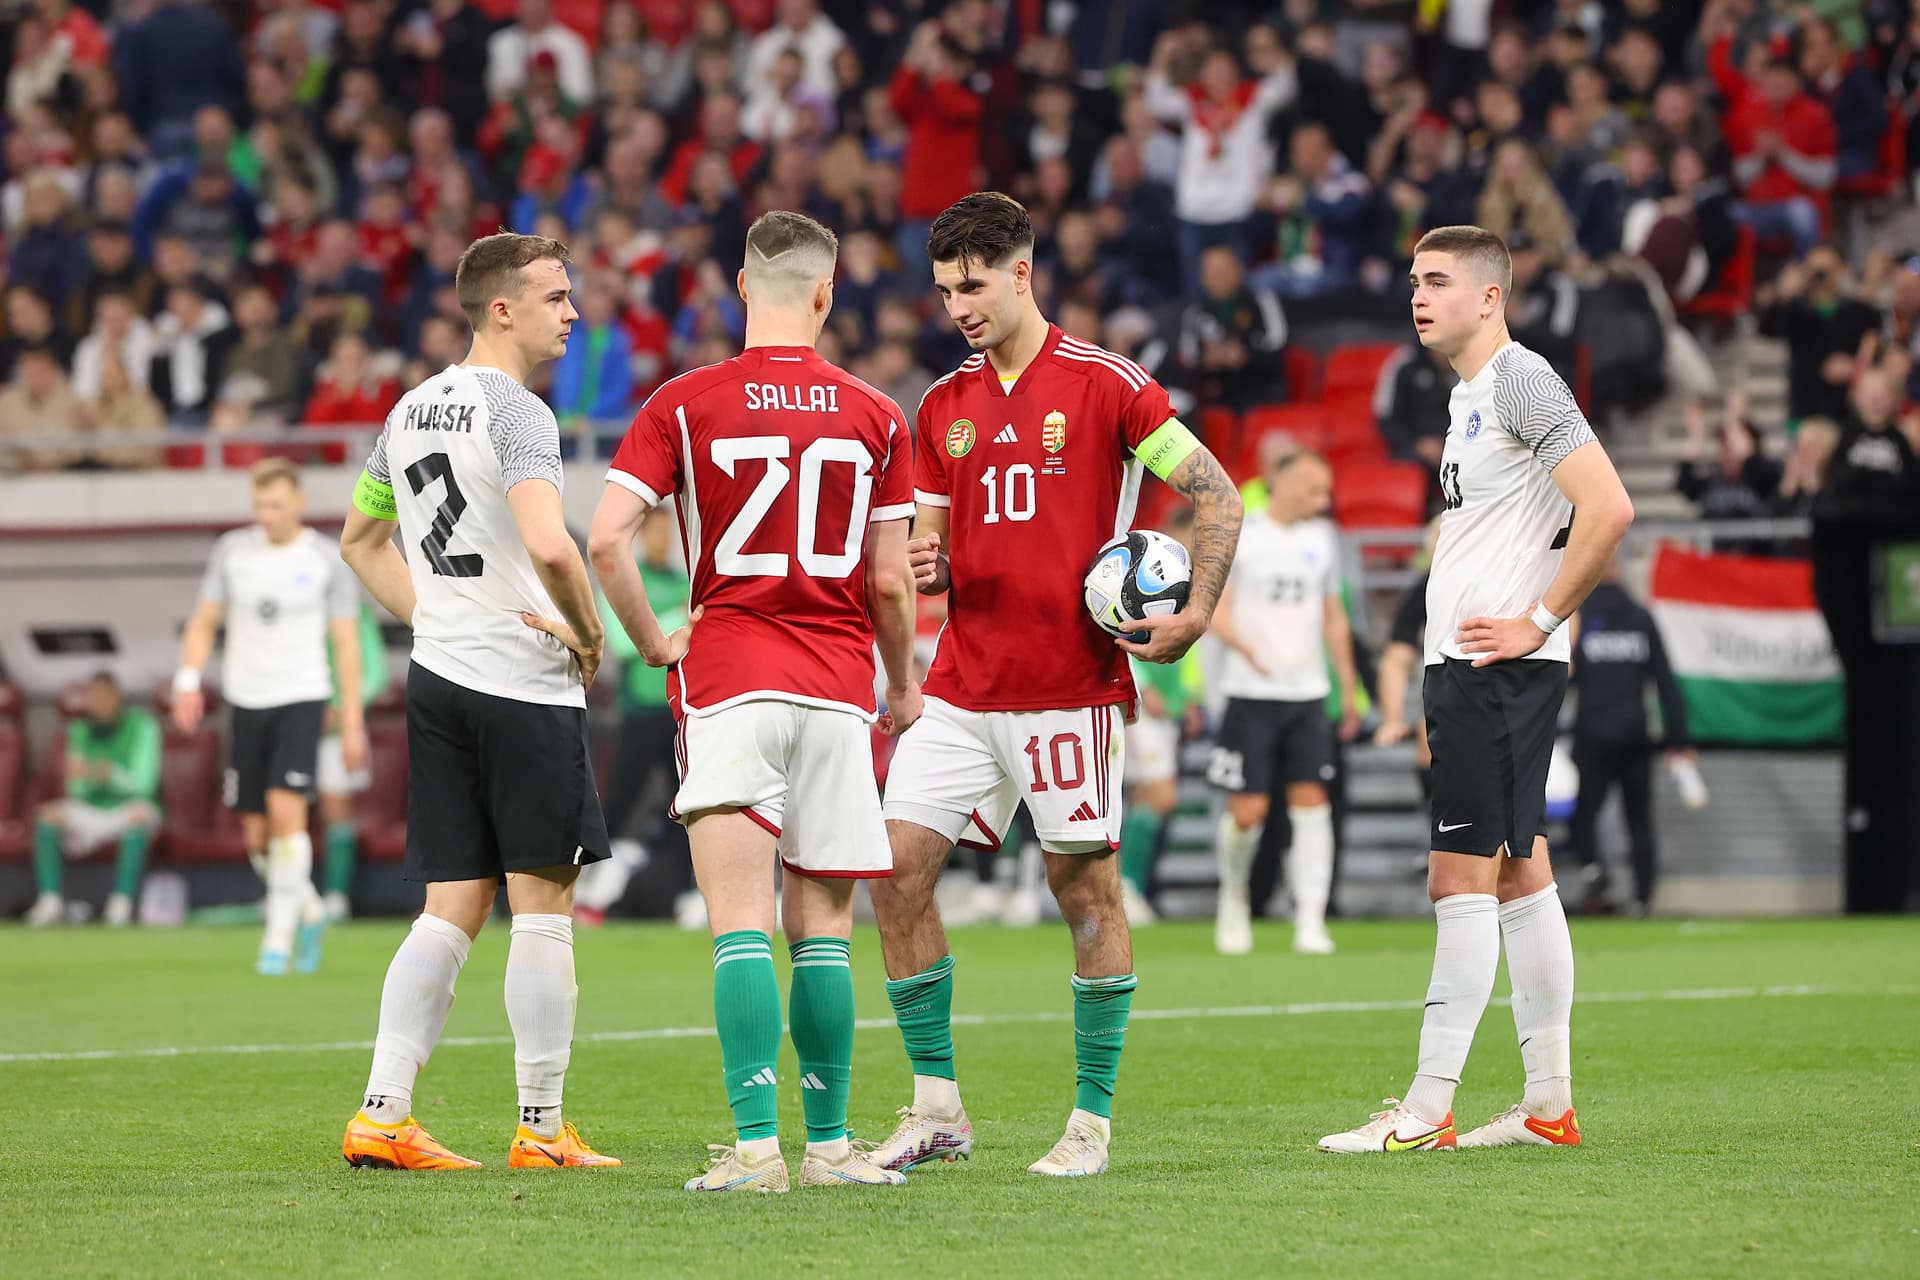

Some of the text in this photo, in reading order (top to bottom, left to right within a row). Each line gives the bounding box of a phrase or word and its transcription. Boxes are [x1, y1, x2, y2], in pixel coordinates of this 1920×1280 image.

[744, 382, 840, 413] SALLAI
[404, 452, 484, 578] 2
[710, 435, 874, 578] 20
[979, 463, 1037, 524] 10
[1023, 732, 1086, 793] 10
